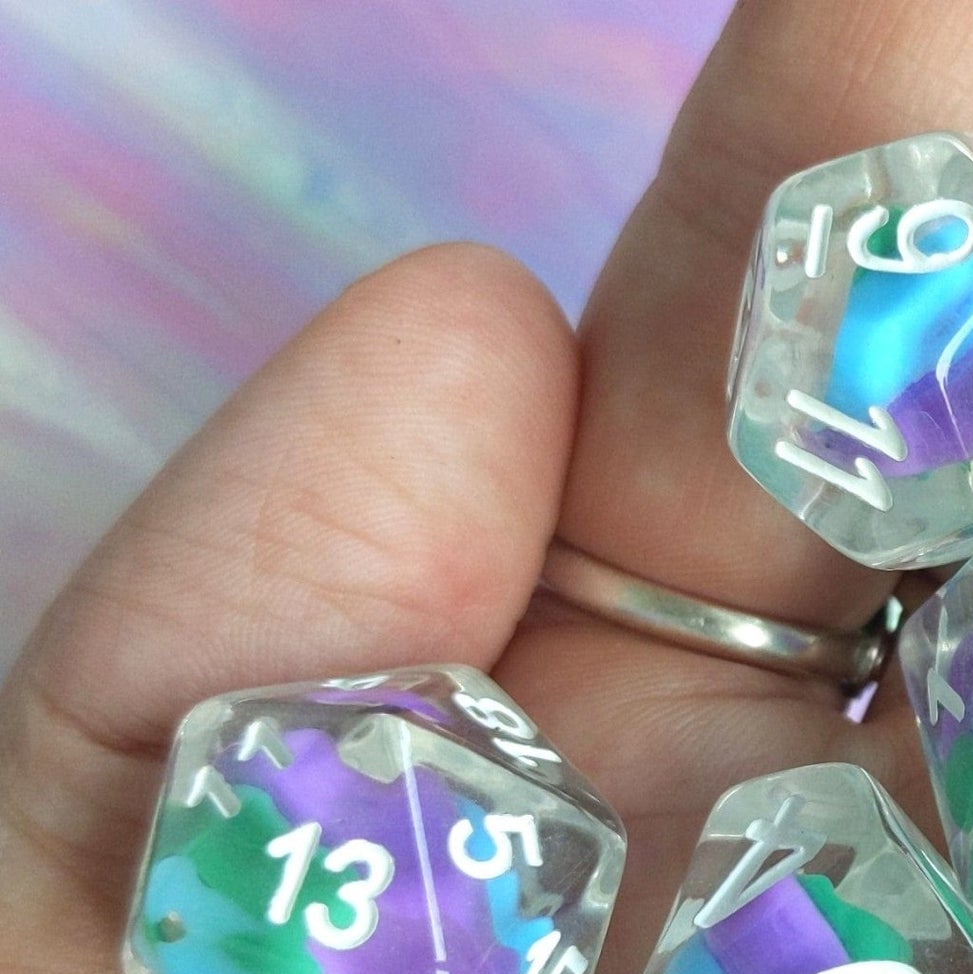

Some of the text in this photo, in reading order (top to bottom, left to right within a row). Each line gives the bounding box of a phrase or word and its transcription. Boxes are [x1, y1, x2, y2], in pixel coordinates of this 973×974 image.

[774, 389, 908, 512] 11
[266, 821, 396, 950] 13
[448, 813, 543, 880] 5
[693, 793, 829, 929] 4
